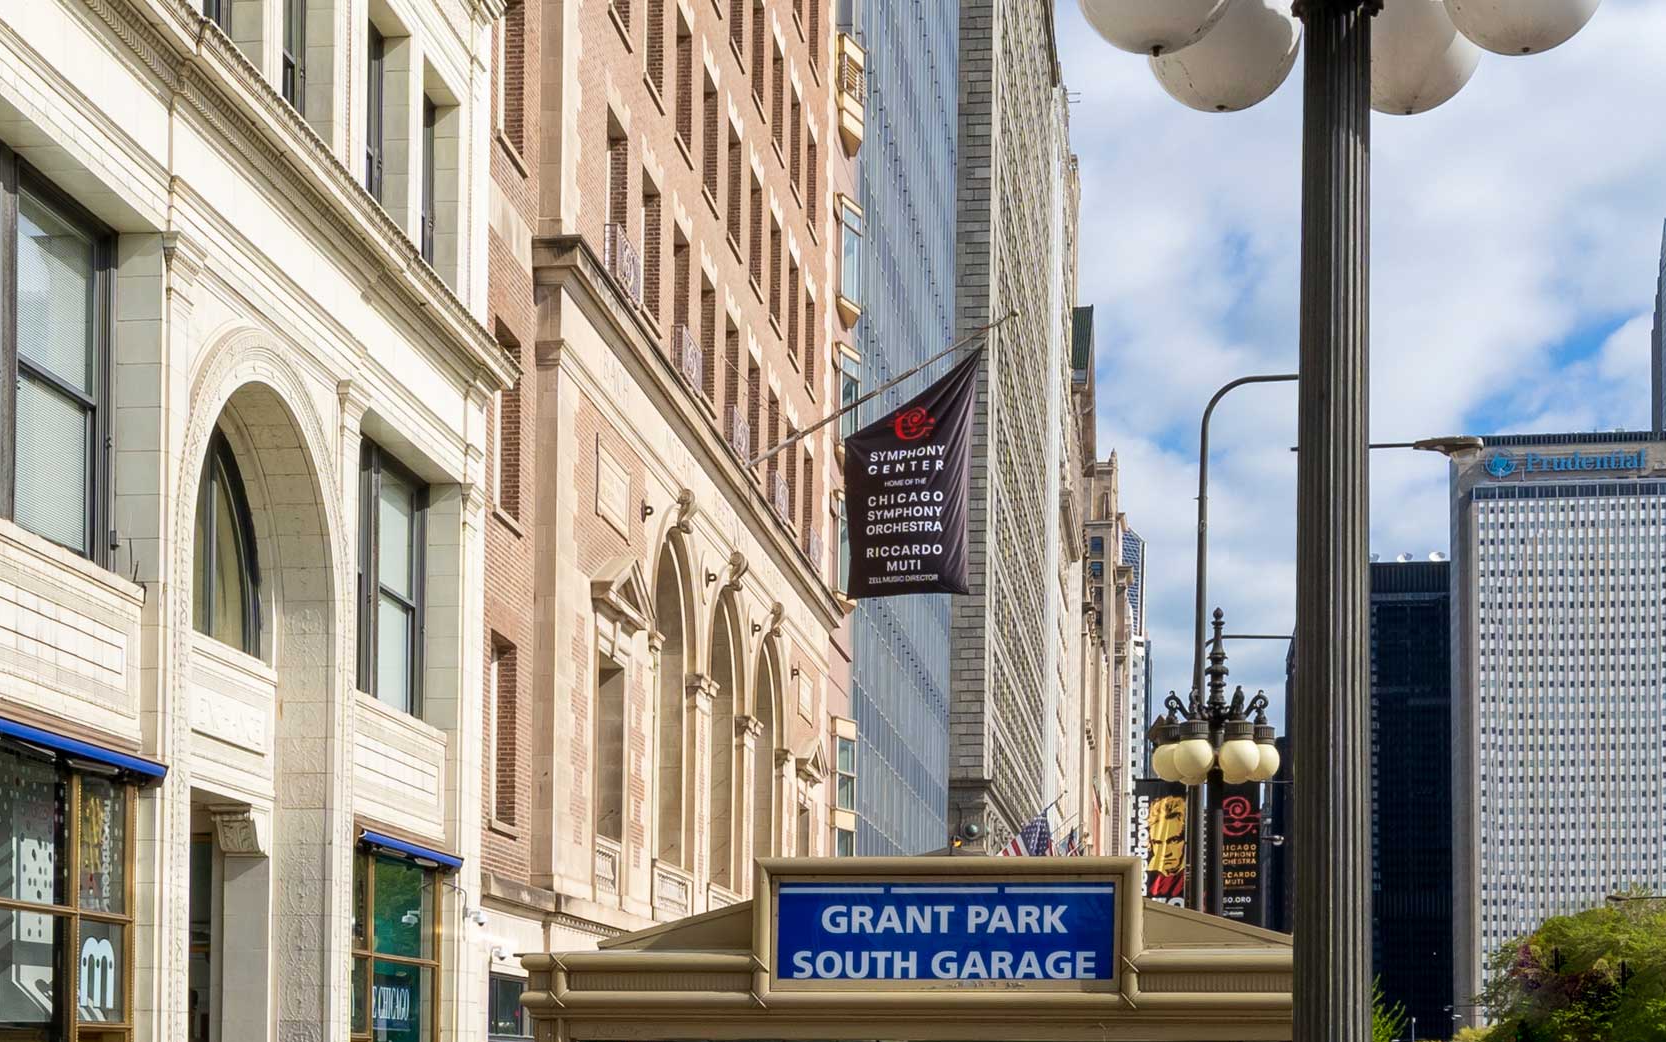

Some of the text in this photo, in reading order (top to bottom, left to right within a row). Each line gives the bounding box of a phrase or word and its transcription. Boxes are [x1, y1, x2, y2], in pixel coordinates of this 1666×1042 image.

[869, 445, 945, 462] SYMPHONY
[1525, 448, 1646, 472] Prudential
[868, 460, 945, 475] CENTER
[884, 479, 903, 487] HOME
[914, 477, 926, 485] THE
[868, 491, 944, 507] CHICAGO
[867, 506, 943, 521] SYMPHONY
[866, 521, 943, 536] ORCHESTRA
[866, 544, 943, 558] RICCARDO
[887, 559, 921, 572] MUTI
[868, 574, 938, 584] ZELL MUSIC DIRECTOR
[821, 905, 1068, 934] GRANT PARK
[80, 936, 115, 1008] m
[792, 950, 1096, 979] SOUTH GARAGE
